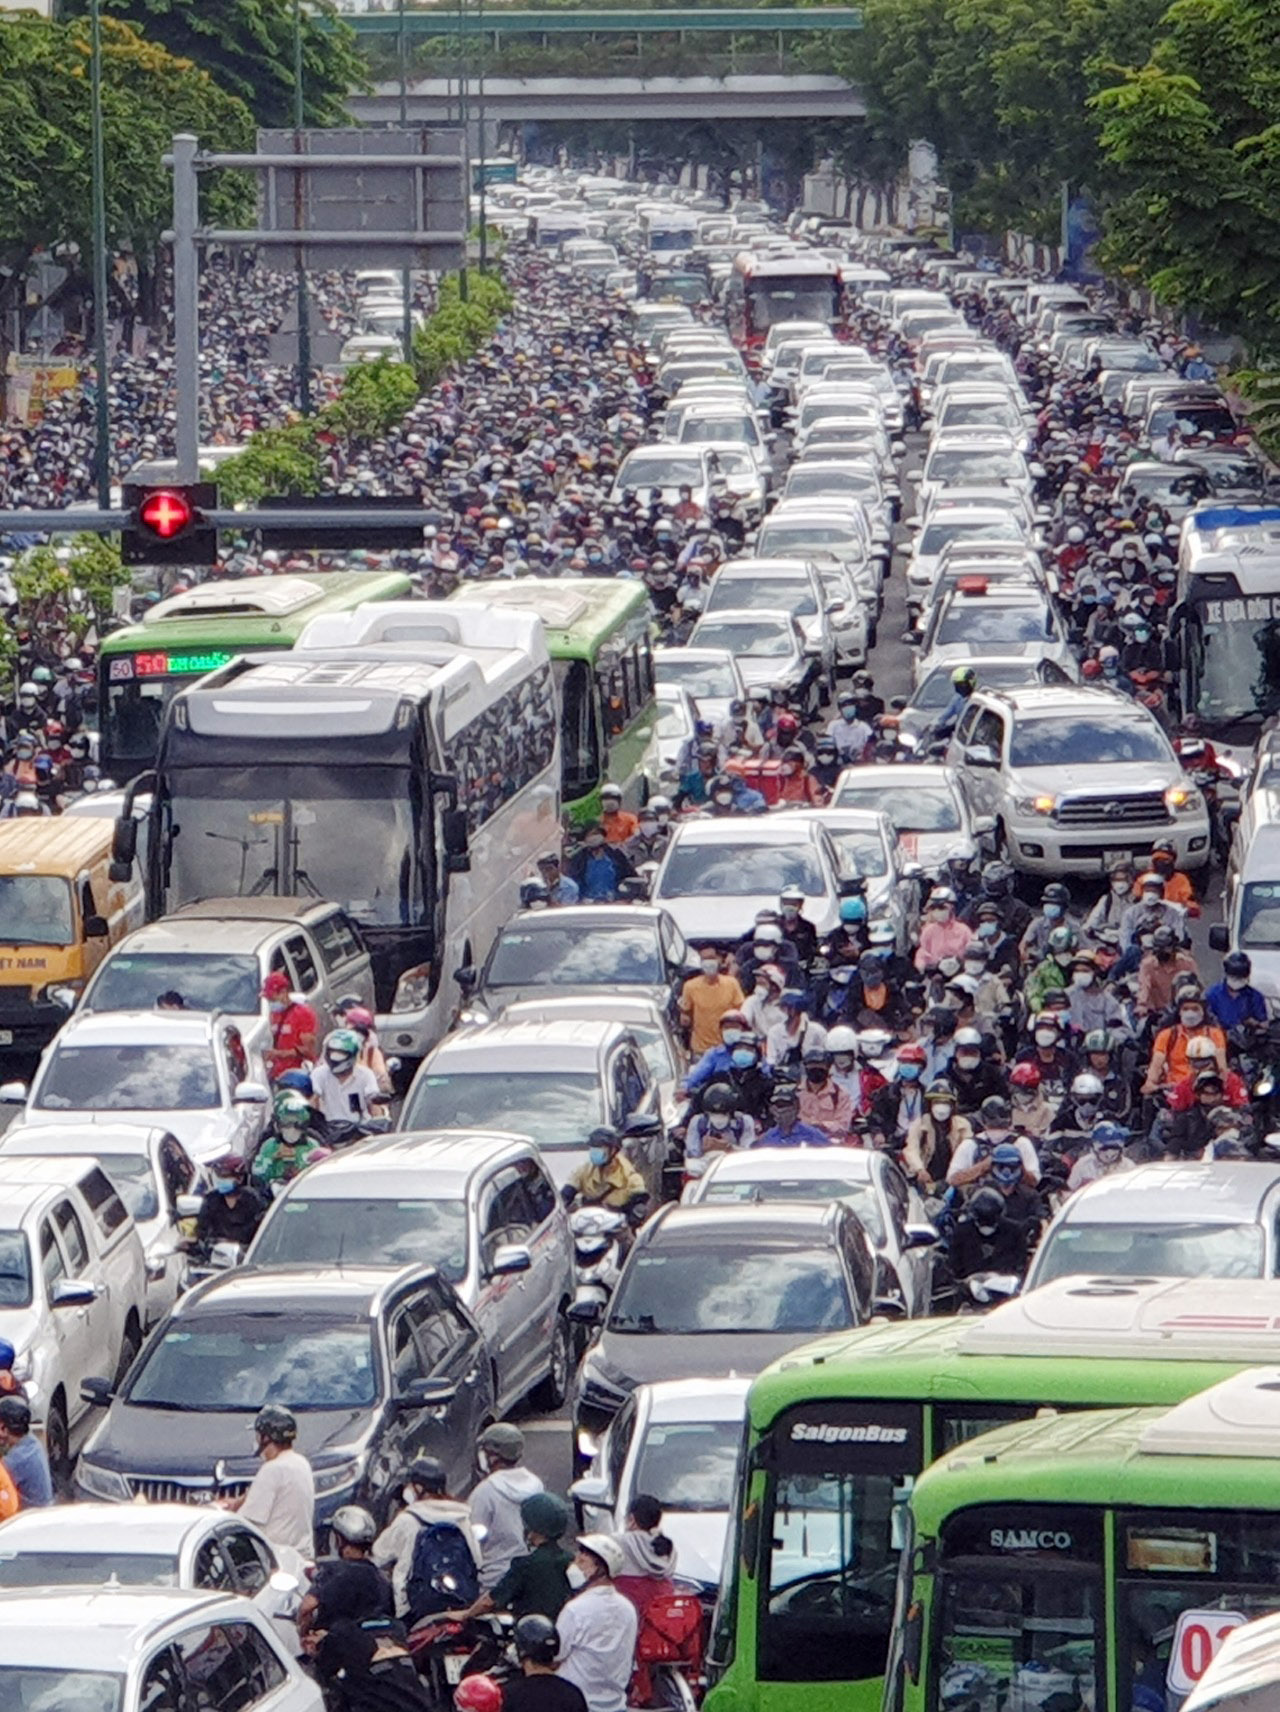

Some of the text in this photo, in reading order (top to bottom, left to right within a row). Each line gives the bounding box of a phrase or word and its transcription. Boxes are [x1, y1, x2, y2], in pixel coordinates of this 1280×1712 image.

[112, 661, 131, 677] 50
[17, 957, 47, 968] NAM
[791, 1423, 908, 1442] SaigonBus
[990, 1528, 1071, 1549] SAMCO
[1181, 1624, 1238, 1682] 0
